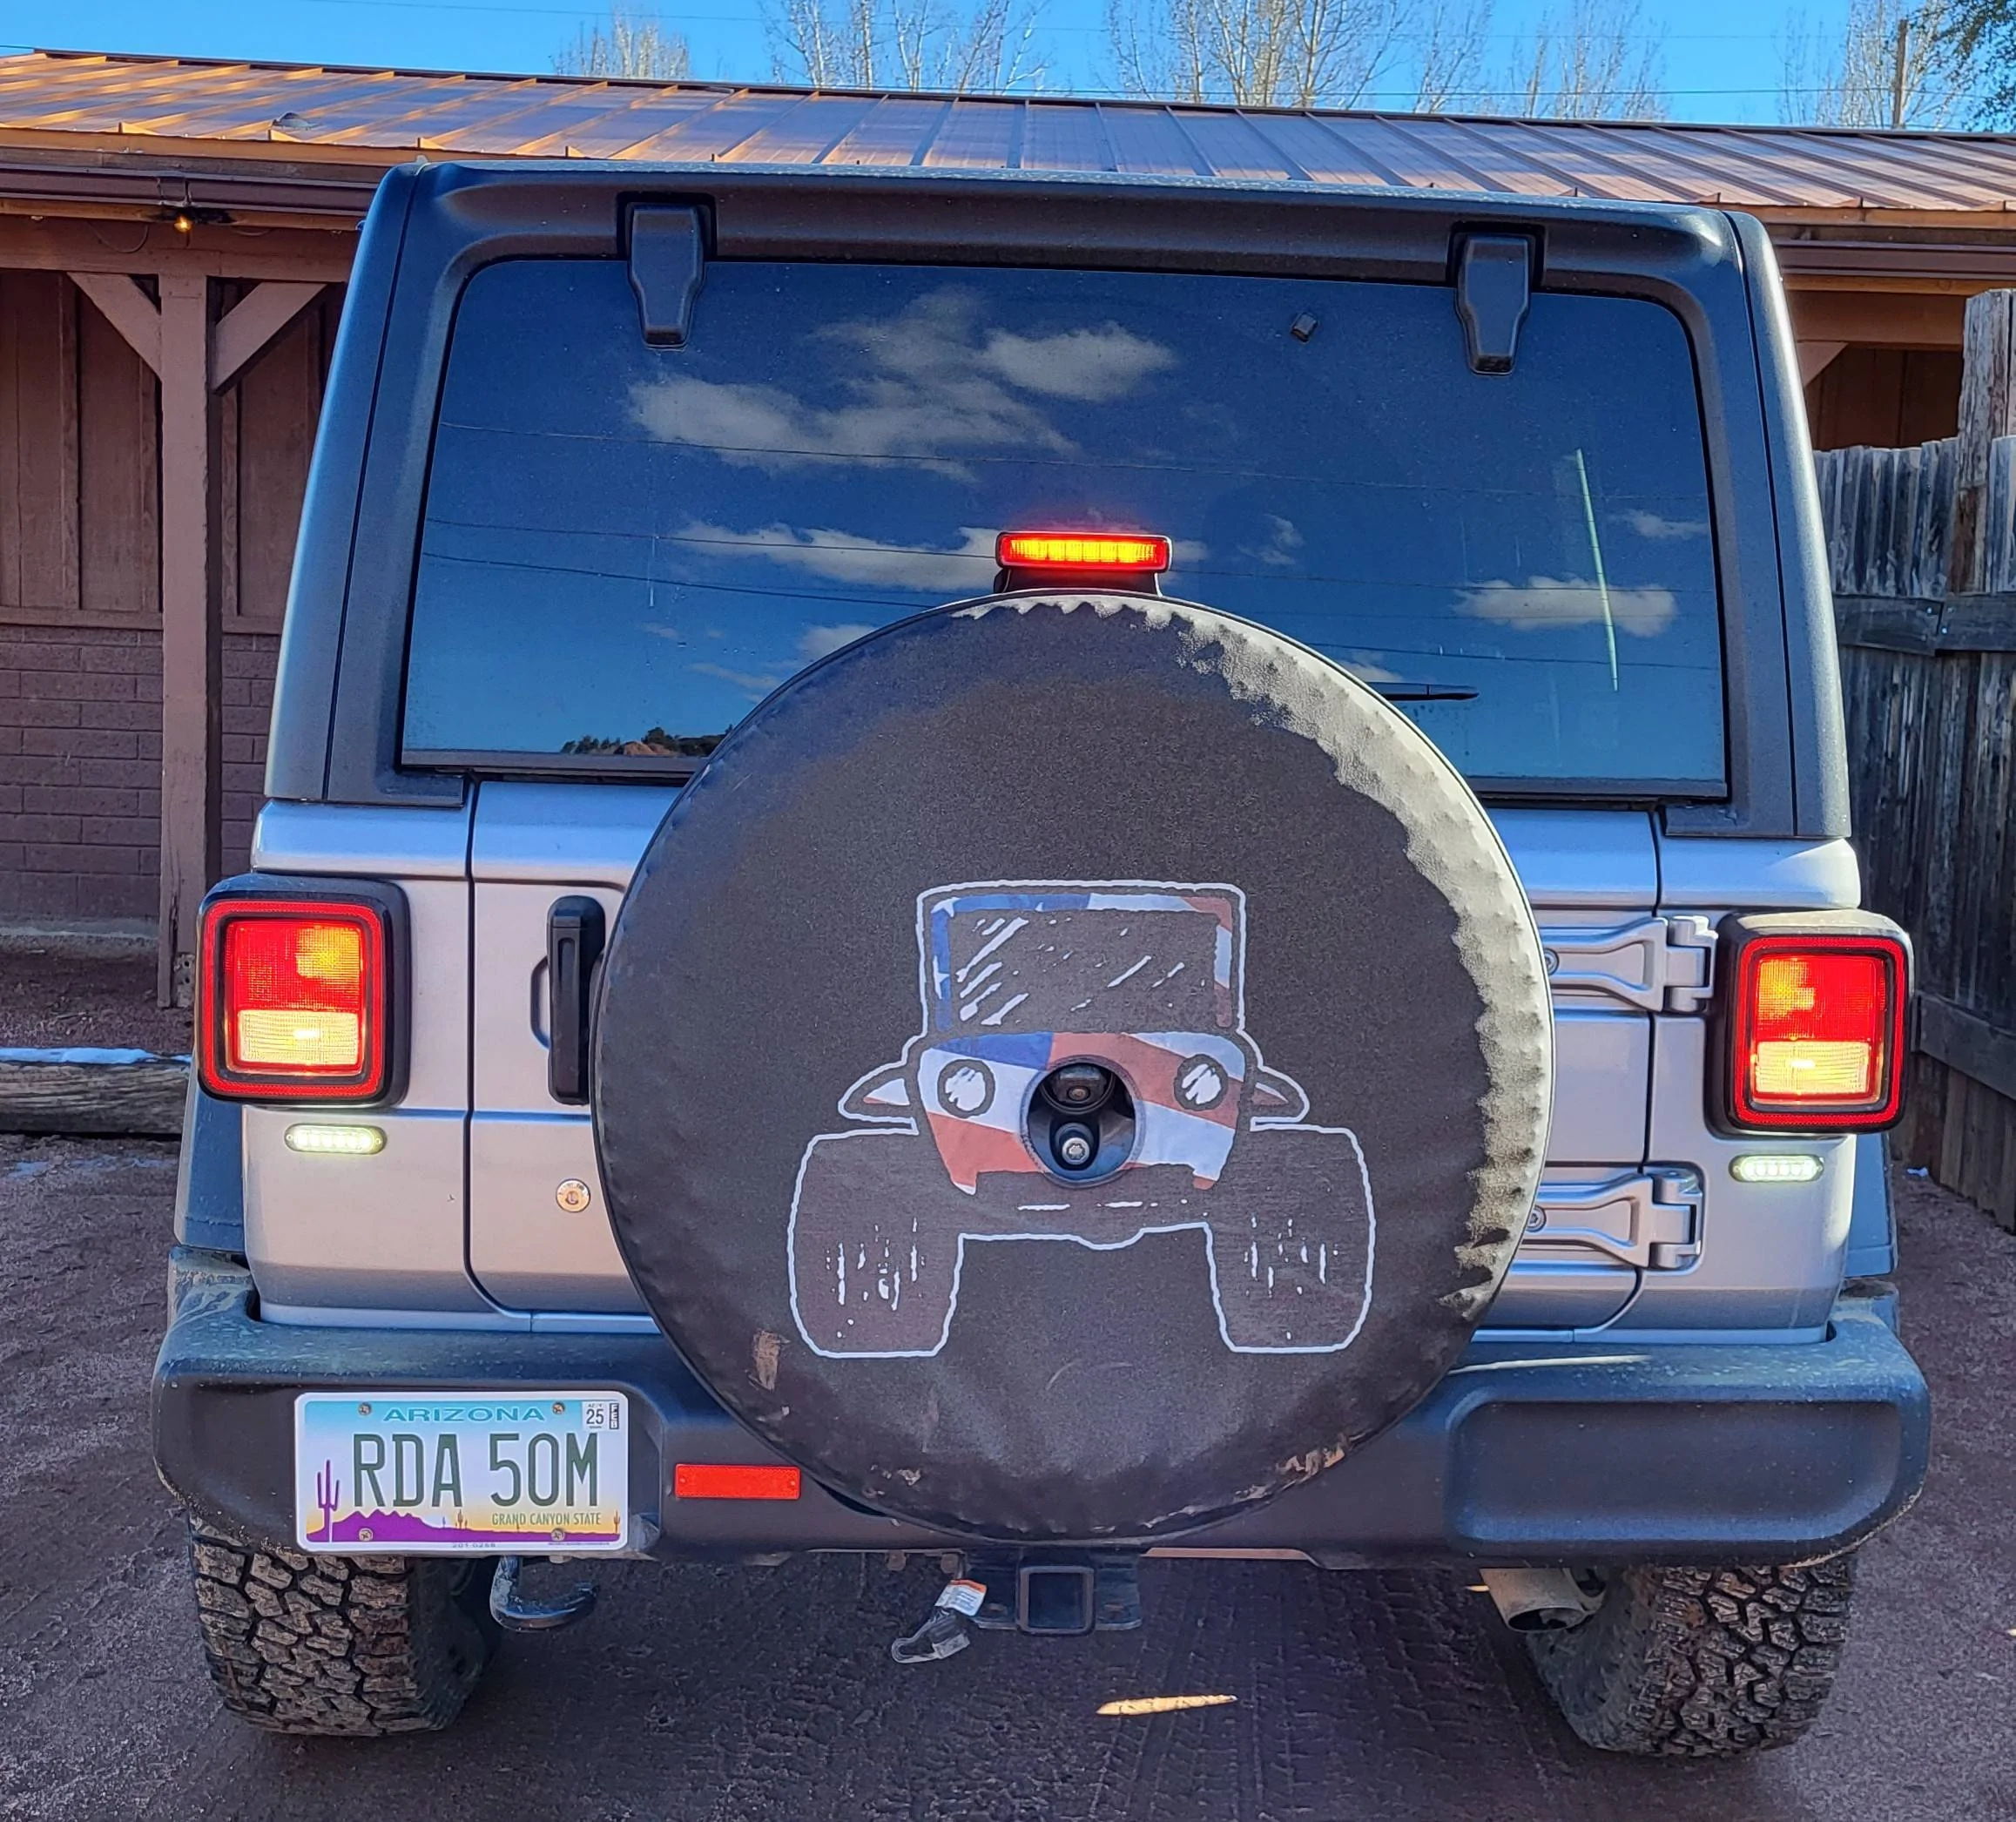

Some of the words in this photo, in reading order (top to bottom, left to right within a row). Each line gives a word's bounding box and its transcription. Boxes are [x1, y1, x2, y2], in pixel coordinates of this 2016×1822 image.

[383, 1407, 544, 1422] ARIZONA
[586, 1408, 604, 1425] 25
[353, 1433, 462, 1508] RDA
[489, 1433, 598, 1507] 50M
[492, 1512, 526, 1526] GRAND
[529, 1512, 571, 1526] CANYON
[573, 1512, 602, 1526] STATE
